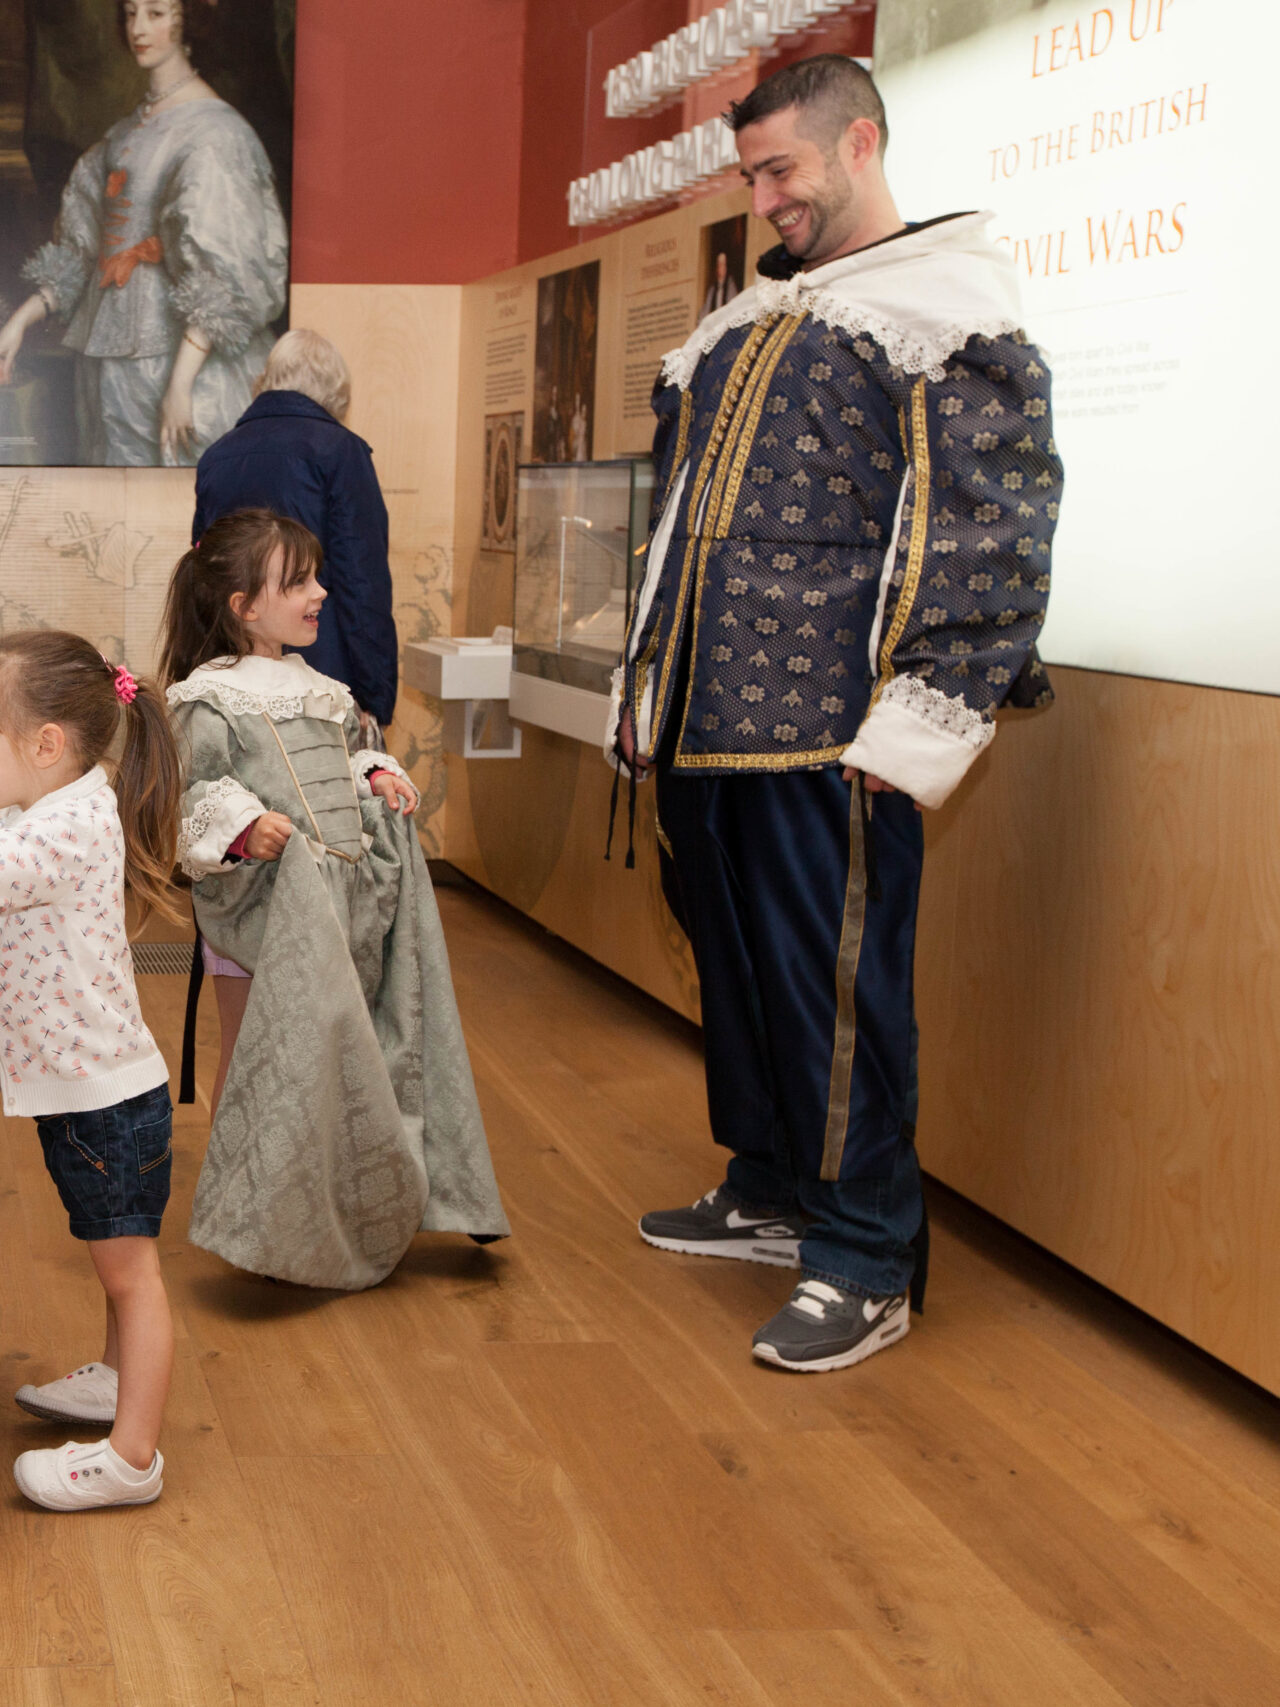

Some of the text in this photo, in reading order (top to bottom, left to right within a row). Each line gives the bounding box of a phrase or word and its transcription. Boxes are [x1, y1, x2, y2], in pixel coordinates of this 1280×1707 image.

[1031, 8, 1114, 79] LEAD
[988, 83, 1208, 182] TO THE BRITISH
[1086, 202, 1187, 267] WARS
